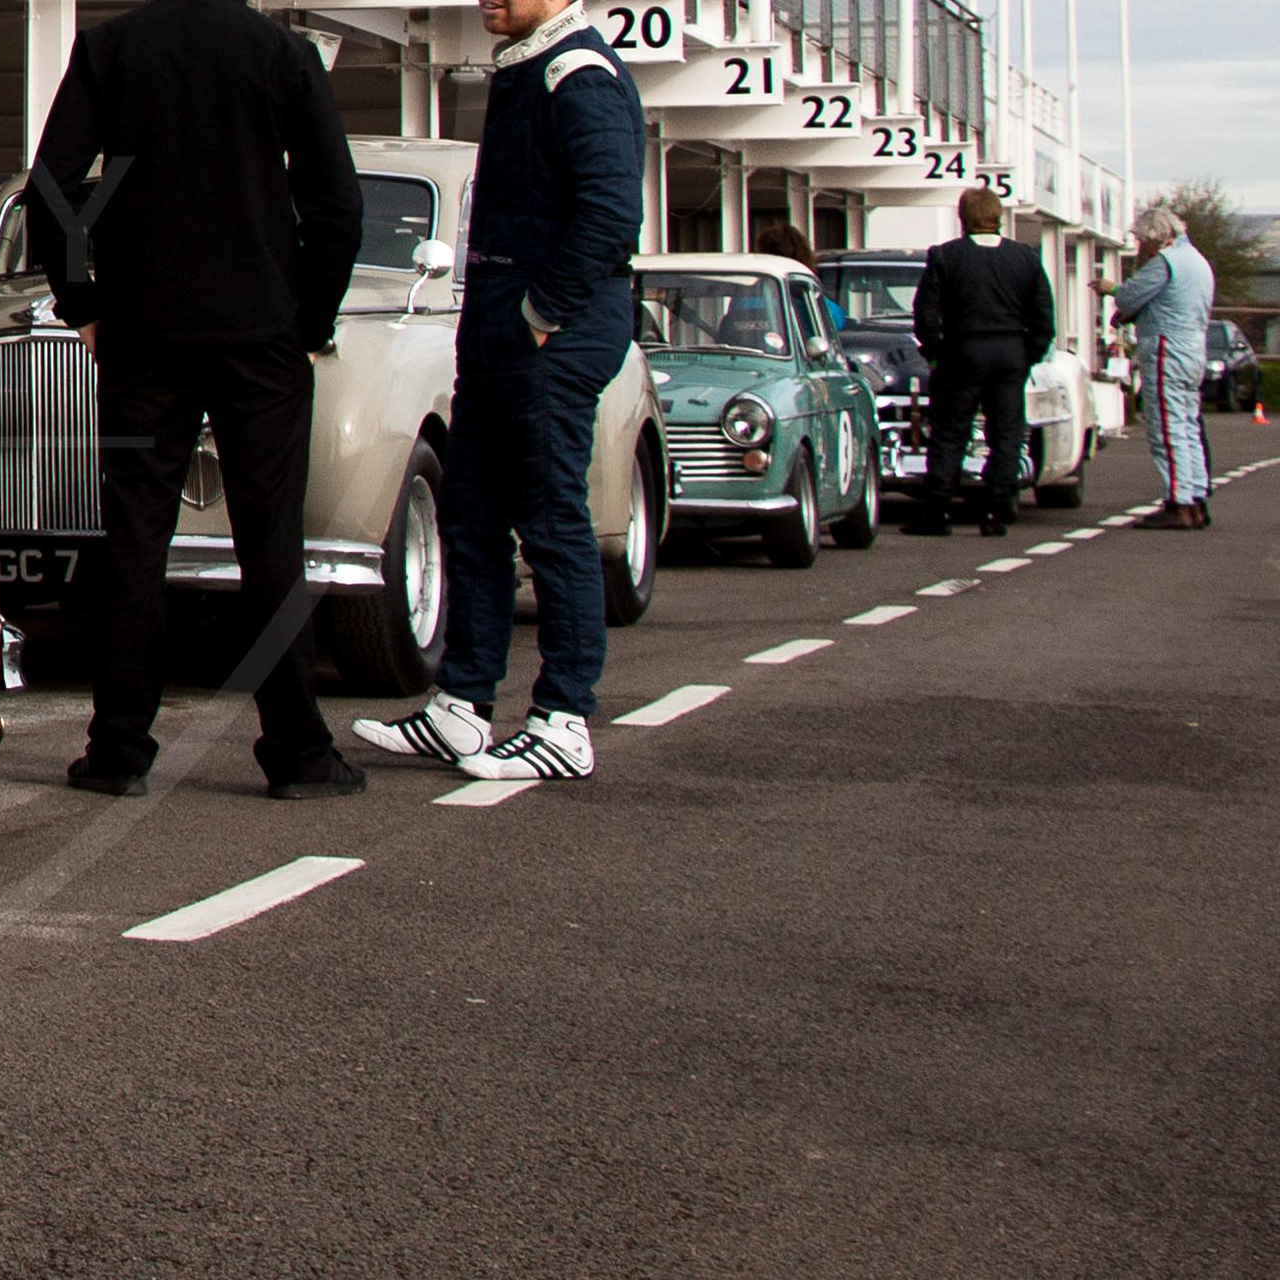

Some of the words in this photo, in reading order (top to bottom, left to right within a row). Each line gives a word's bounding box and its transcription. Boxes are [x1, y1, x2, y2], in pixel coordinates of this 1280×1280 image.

[606, 5, 673, 50] 20
[724, 58, 773, 95] 21
[802, 95, 853, 128] 22
[872, 127, 918, 158] 23
[924, 152, 966, 179] 24
[55, 549, 79, 583] 7
